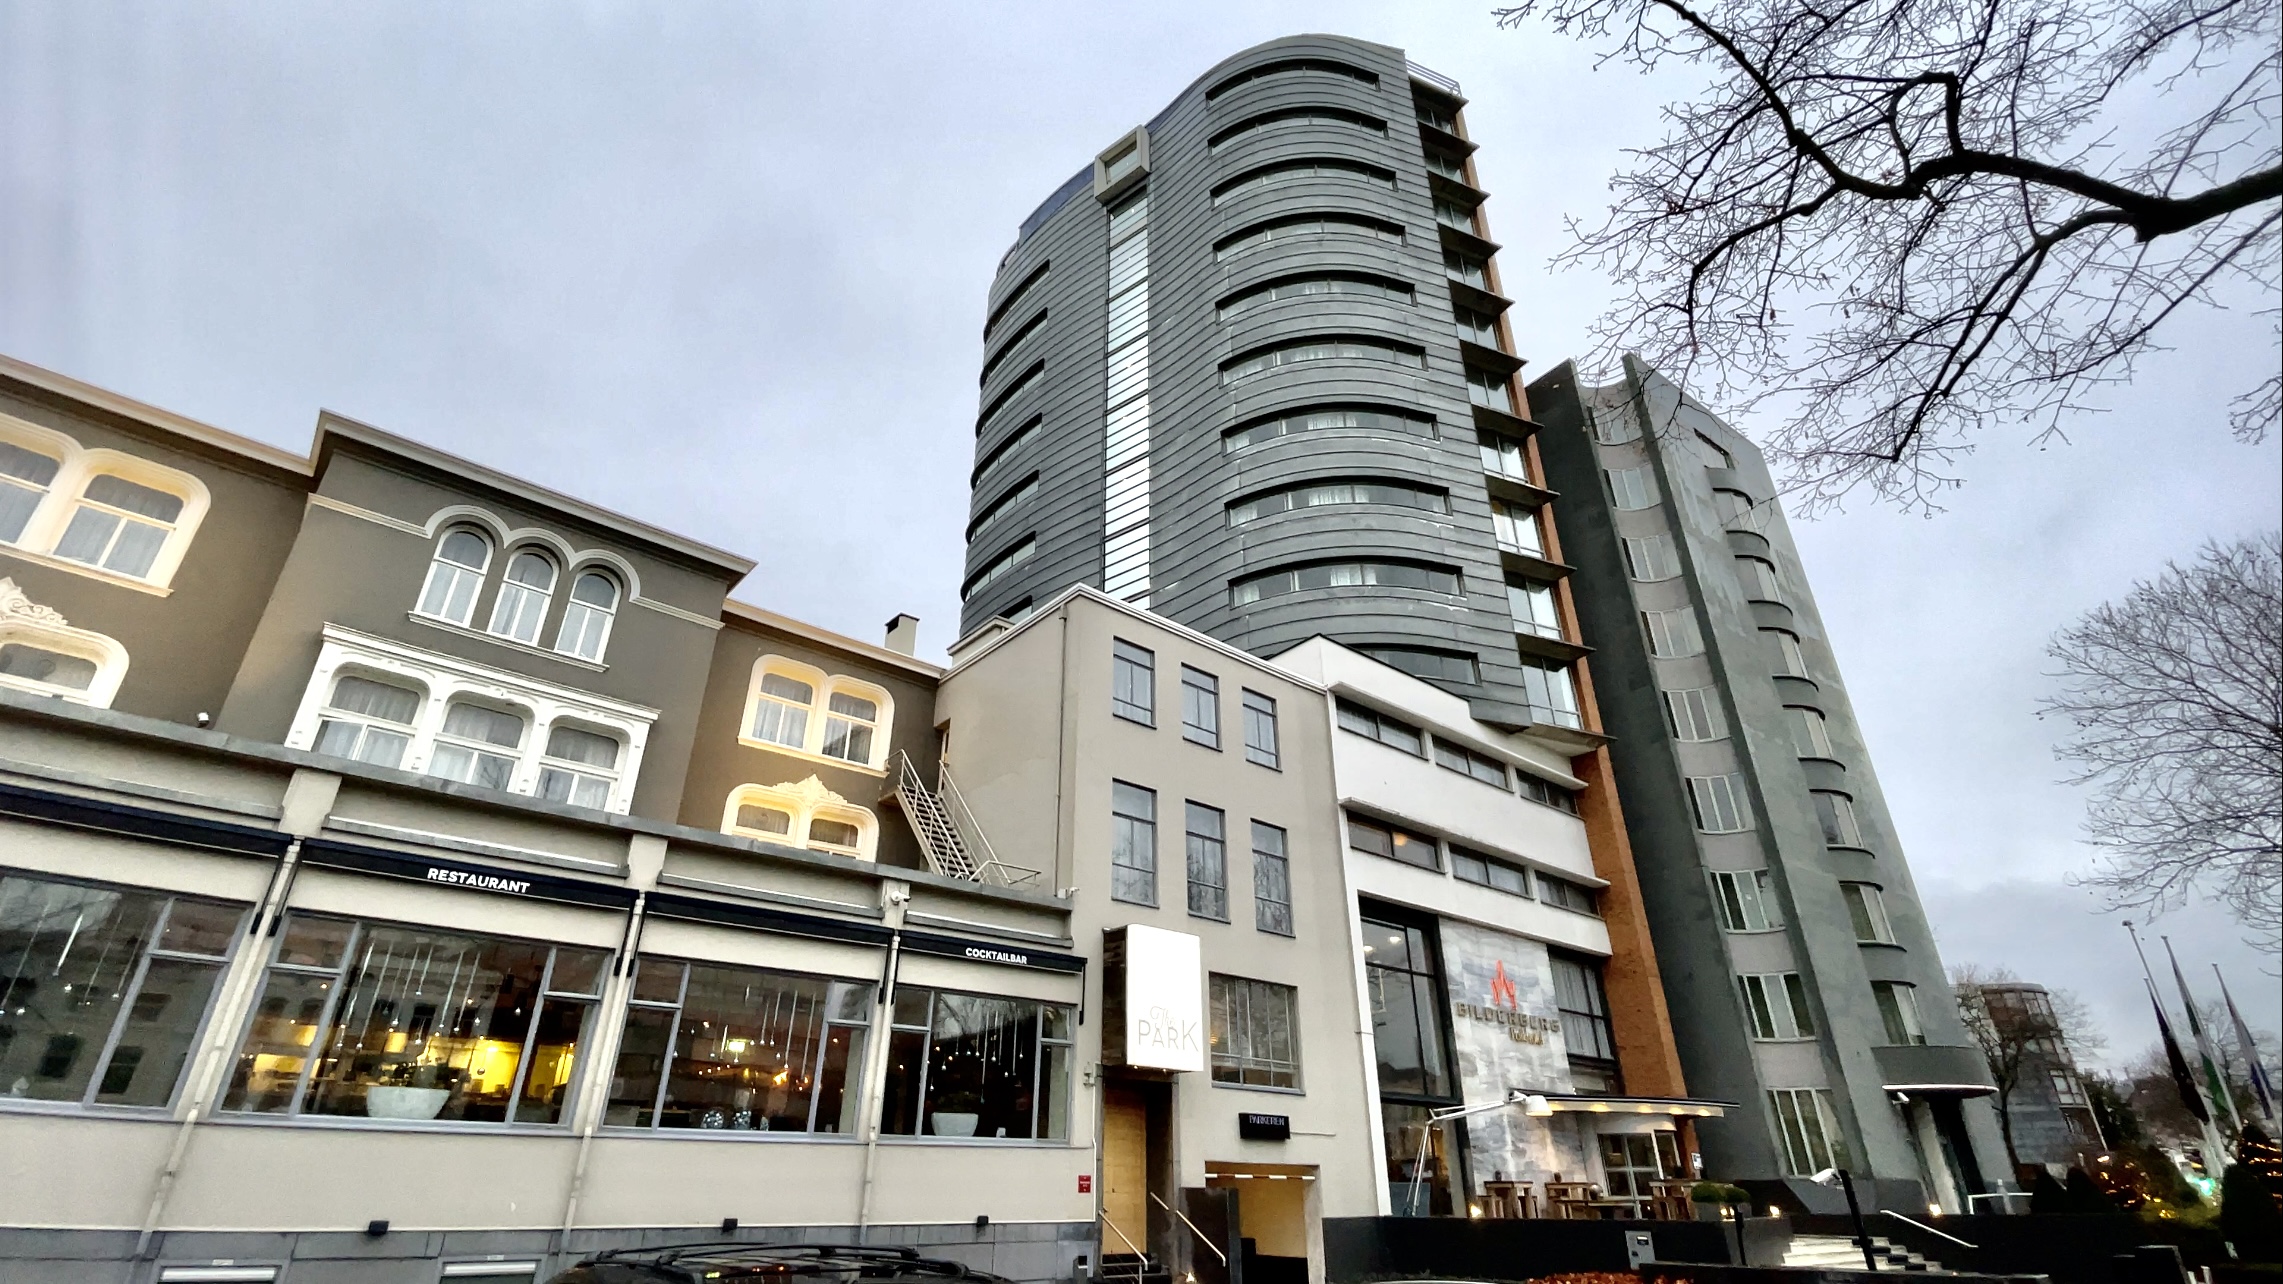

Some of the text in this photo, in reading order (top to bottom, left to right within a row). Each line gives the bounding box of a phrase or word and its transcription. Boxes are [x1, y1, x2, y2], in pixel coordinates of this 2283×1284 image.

[427, 867, 530, 893] RESTAURANT
[965, 947, 1027, 965] COCKTAILBAR
[1456, 1001, 1560, 1033] BILDERBERG
[1138, 1018, 1199, 1052] PARK
[1249, 1114, 1285, 1126] PARKEREN
